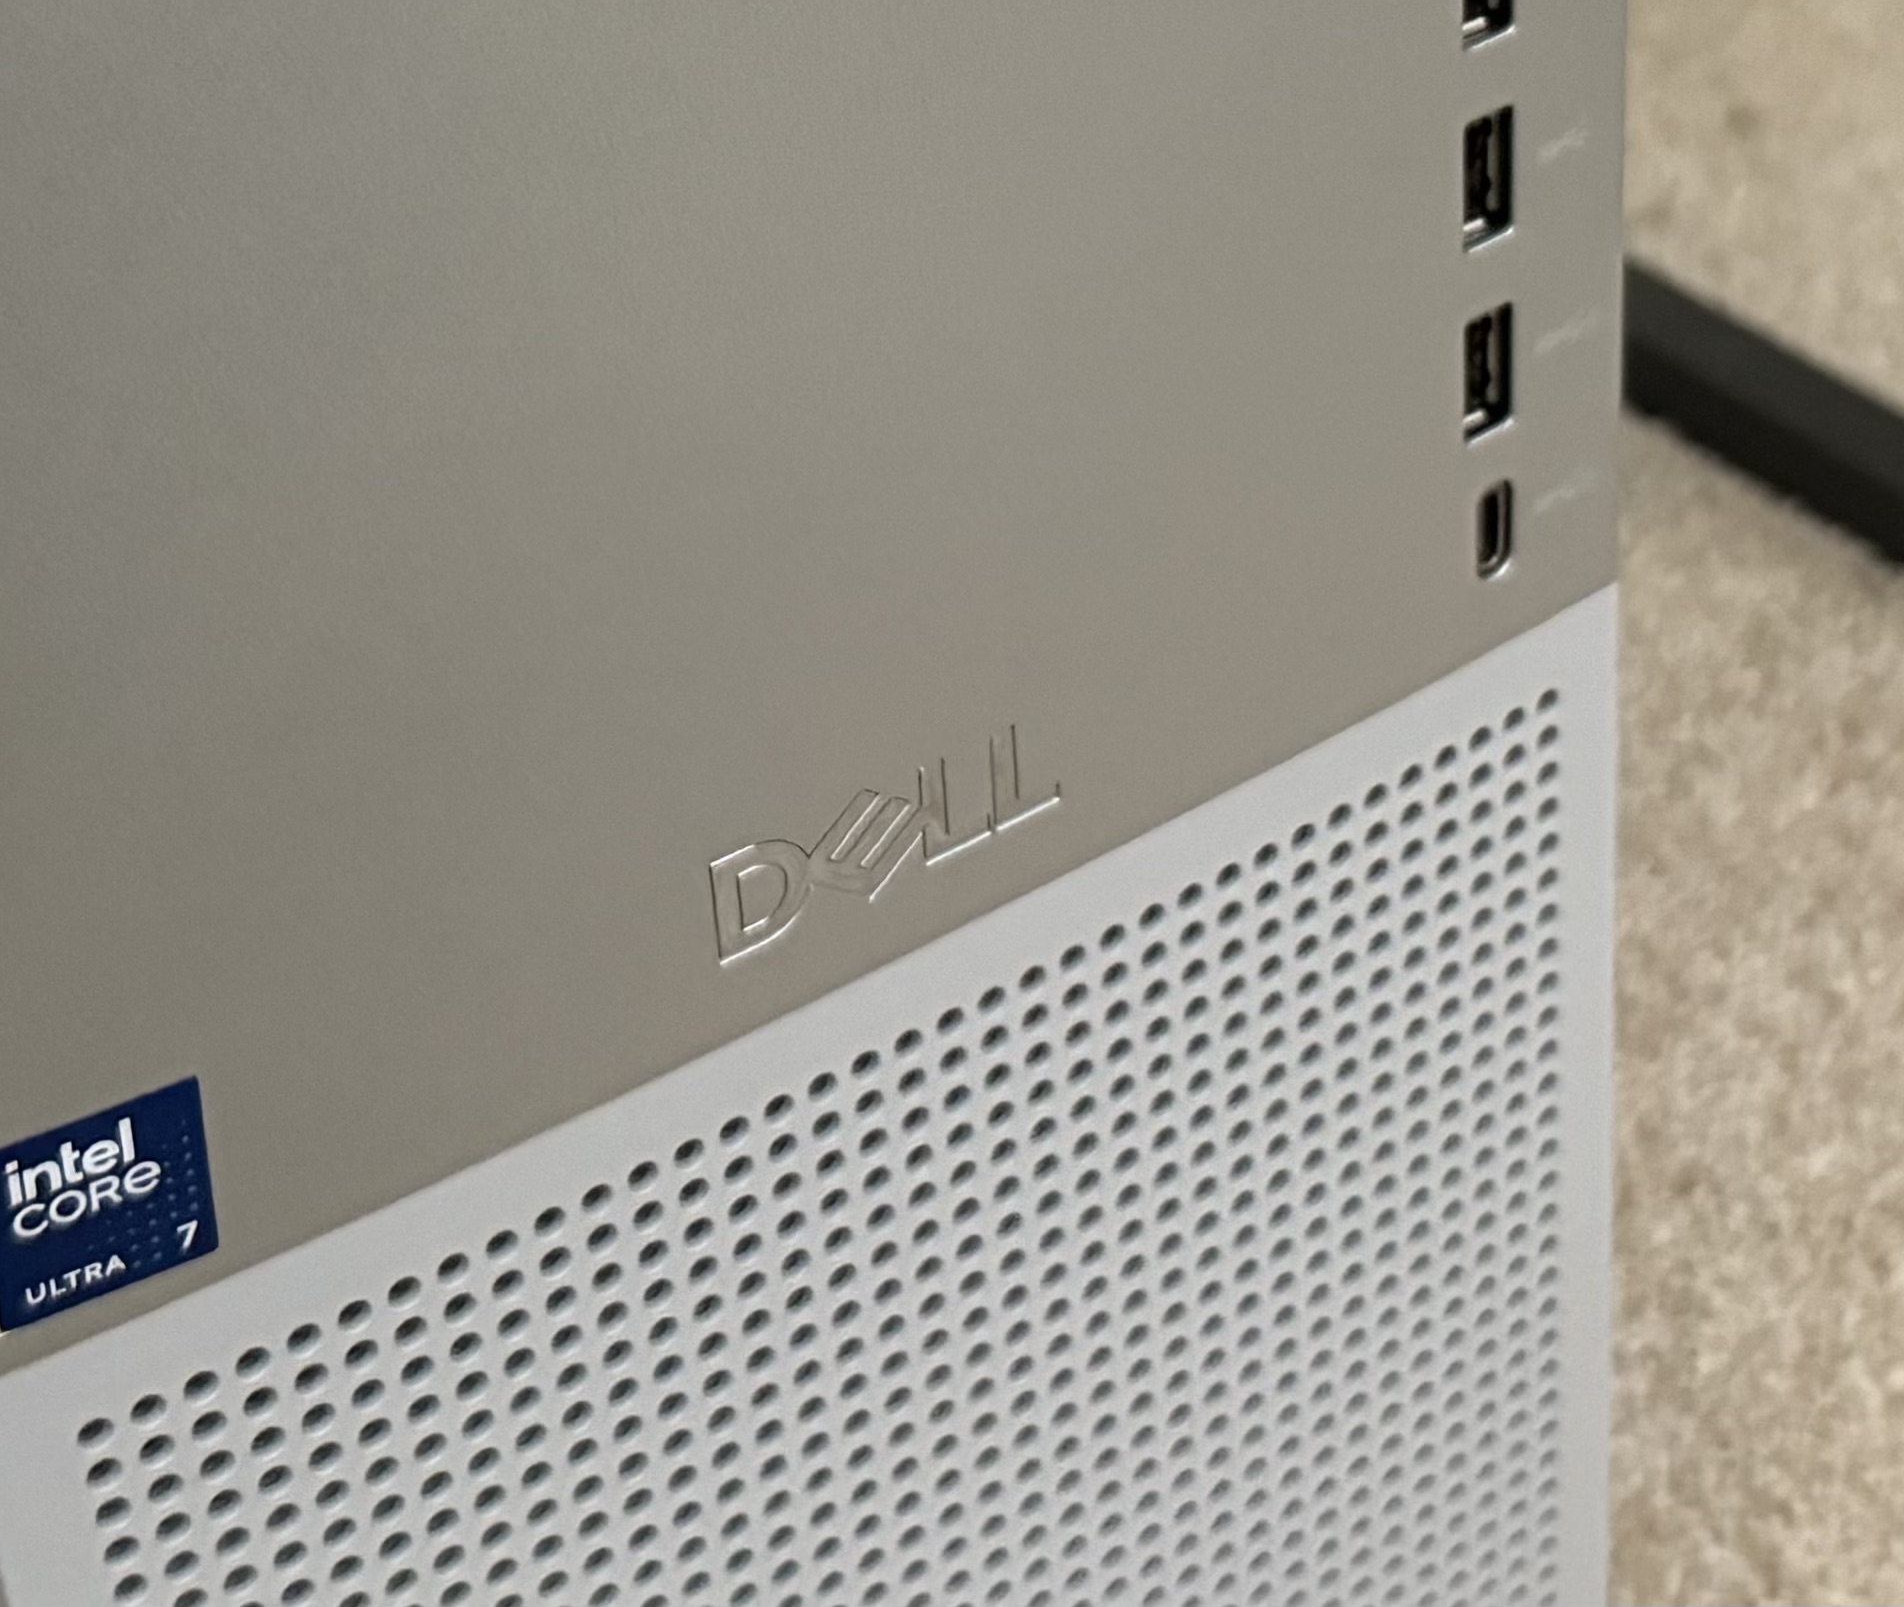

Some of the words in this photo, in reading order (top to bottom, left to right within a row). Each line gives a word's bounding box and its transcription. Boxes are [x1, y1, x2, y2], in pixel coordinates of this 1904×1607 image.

[709, 723, 1061, 968] DELL
[4, 1116, 136, 1208] intel
[24, 1253, 127, 1305] ULTRA
[175, 1219, 199, 1254] 7
